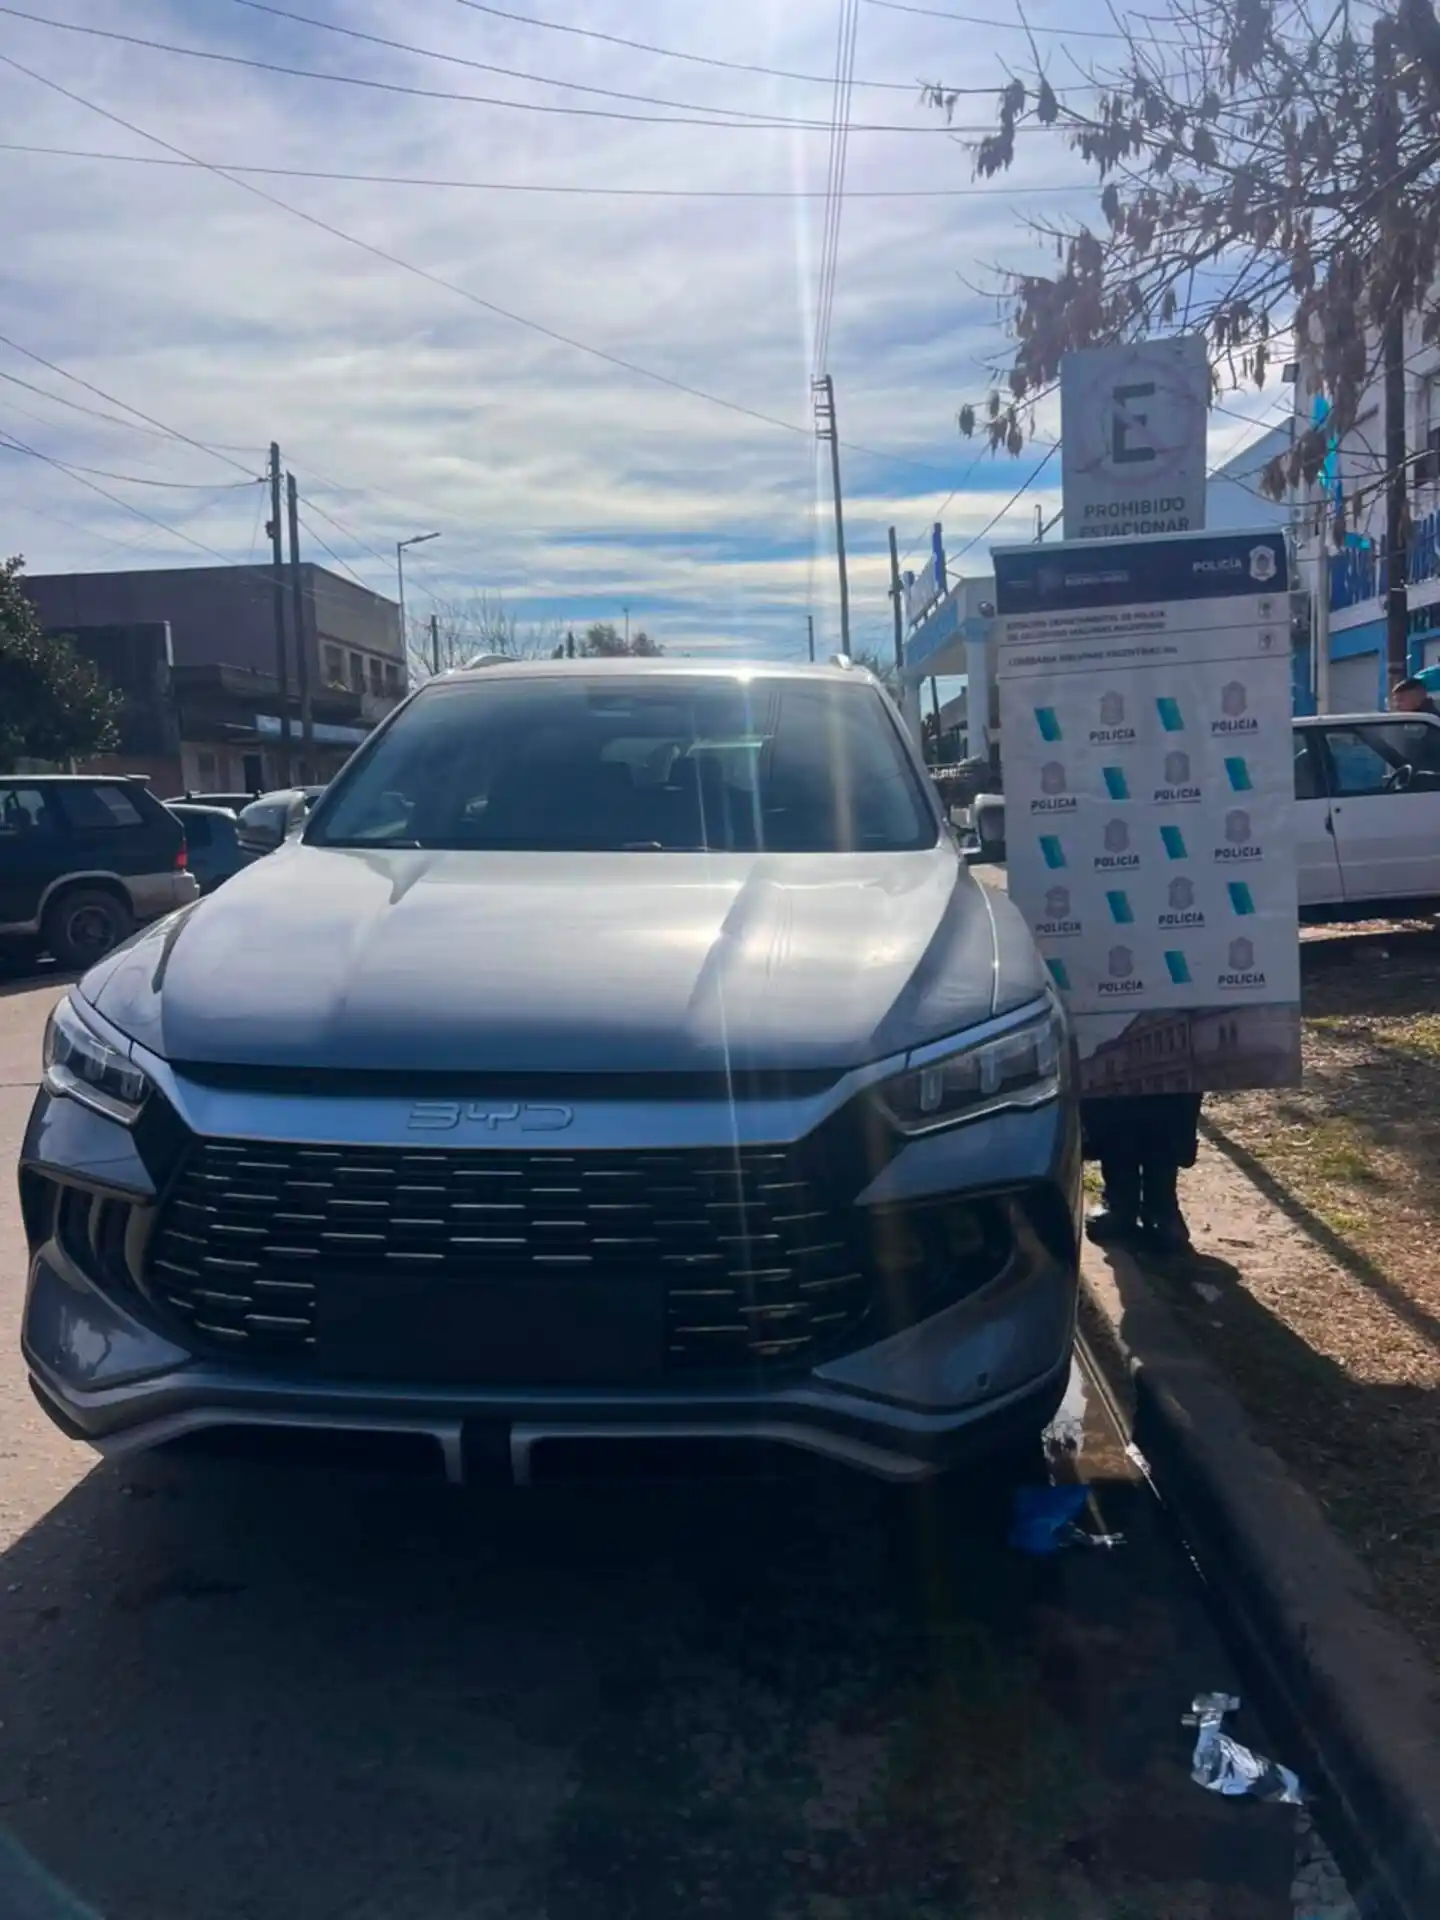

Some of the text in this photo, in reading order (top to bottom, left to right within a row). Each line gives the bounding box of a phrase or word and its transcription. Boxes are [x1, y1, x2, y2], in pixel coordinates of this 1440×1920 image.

[1113, 381, 1156, 464] E
[1083, 497, 1186, 519] PROHIBIDO
[1079, 517, 1190, 538] ESTACIONAR
[407, 1102, 574, 1132] BYD
